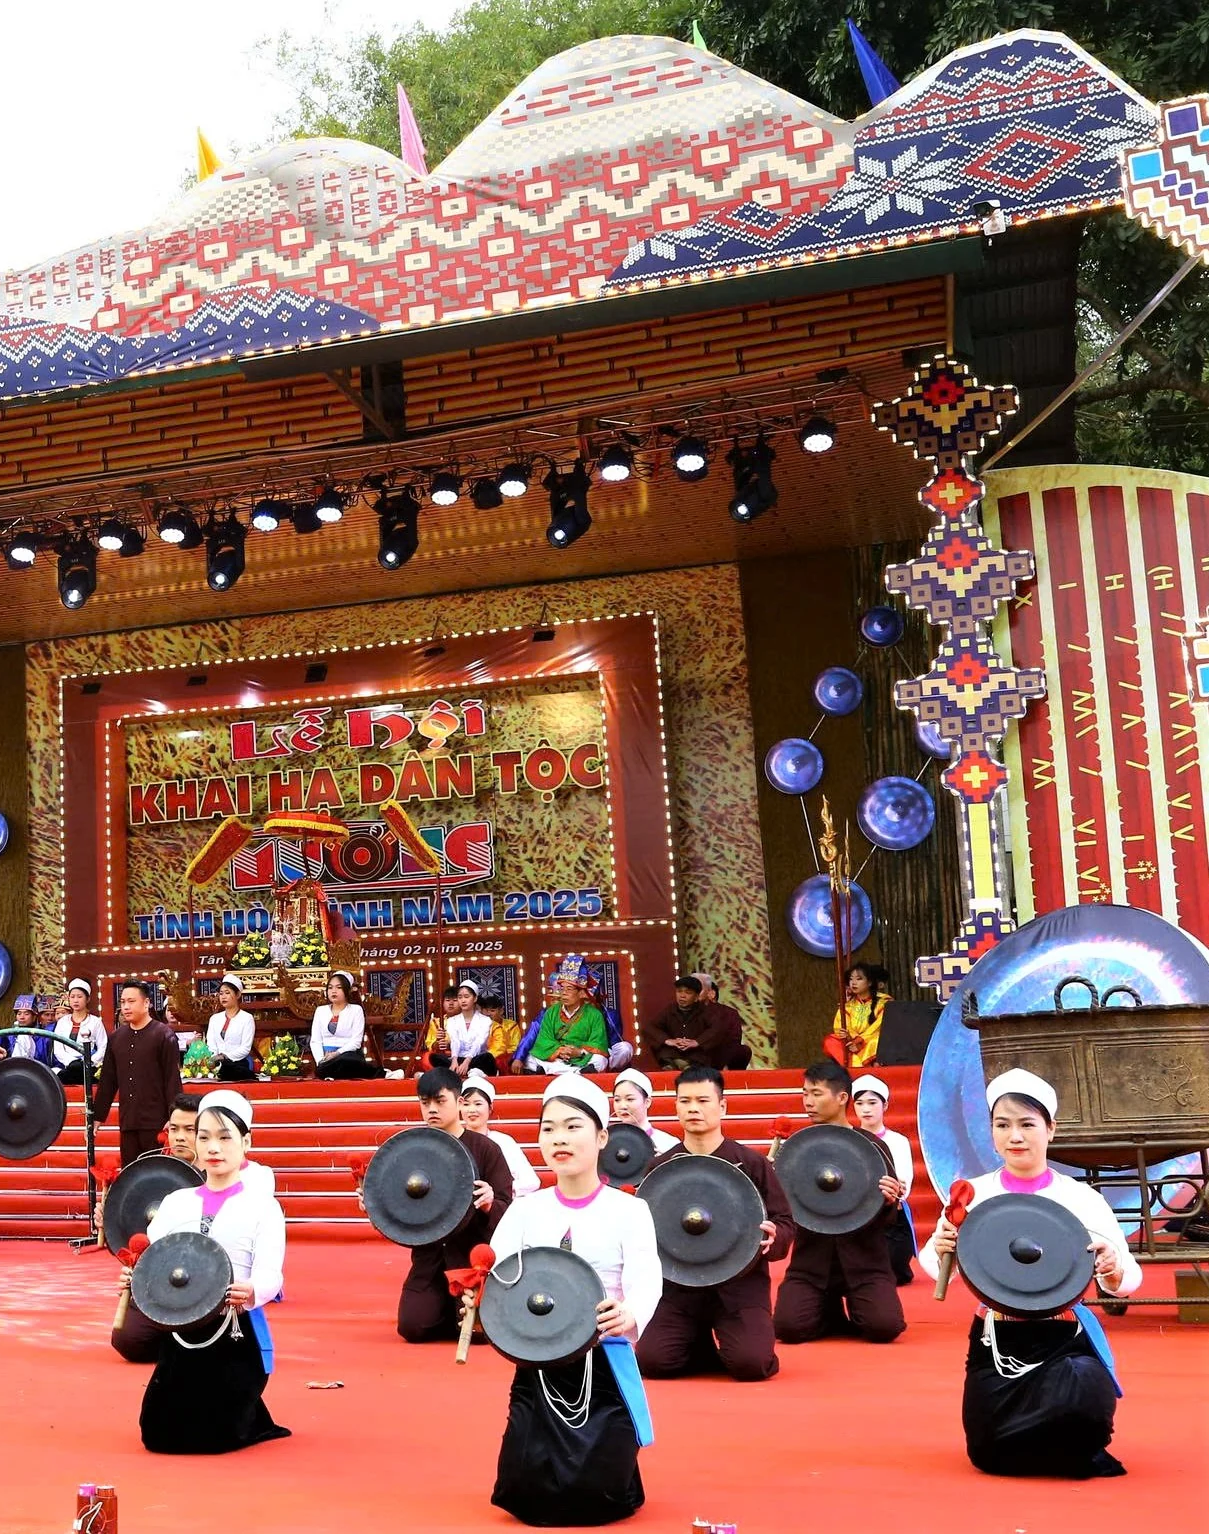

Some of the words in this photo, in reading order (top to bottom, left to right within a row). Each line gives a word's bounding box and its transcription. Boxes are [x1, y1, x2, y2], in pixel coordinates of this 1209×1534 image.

[230, 706, 333, 762] Lễ
[344, 699, 486, 750] Hội
[128, 773, 253, 826] KHAI
[267, 766, 345, 817] HẠ
[358, 750, 476, 806] DÂN
[490, 737, 604, 804] TỘC
[134, 905, 215, 942] TỈNH
[222, 900, 275, 937] HÒ
[327, 896, 394, 930] ÌNH
[401, 889, 495, 927] NĂM
[503, 887, 603, 921] 2025
[198, 954, 225, 966] Tân
[360, 946, 398, 959] háng
[403, 945, 422, 956] 02
[465, 940, 503, 953] 2025
